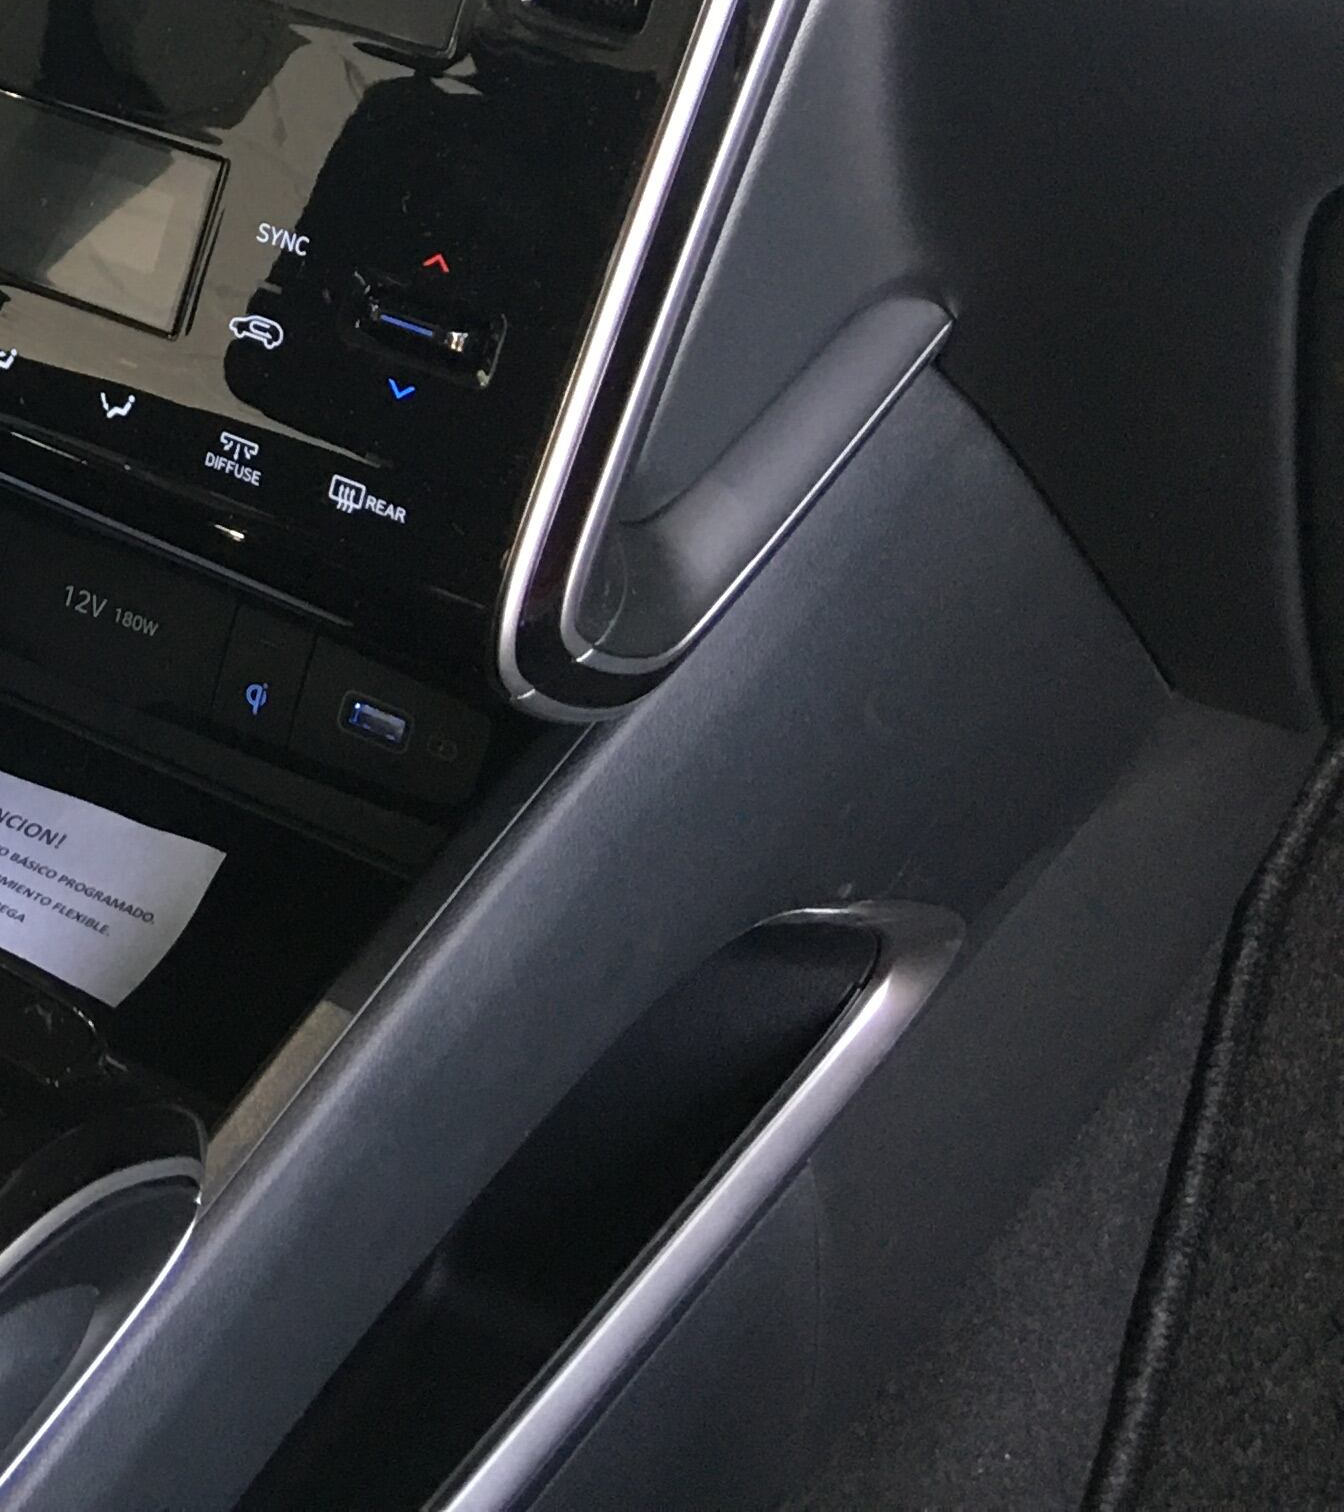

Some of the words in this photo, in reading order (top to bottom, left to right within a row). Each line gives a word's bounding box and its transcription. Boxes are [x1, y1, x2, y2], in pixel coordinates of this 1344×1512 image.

[256, 223, 310, 256] SYNC
[205, 451, 261, 486] DIFFUSE
[365, 496, 406, 524] REAR
[65, 585, 108, 618] 12V
[114, 608, 159, 637] 180W
